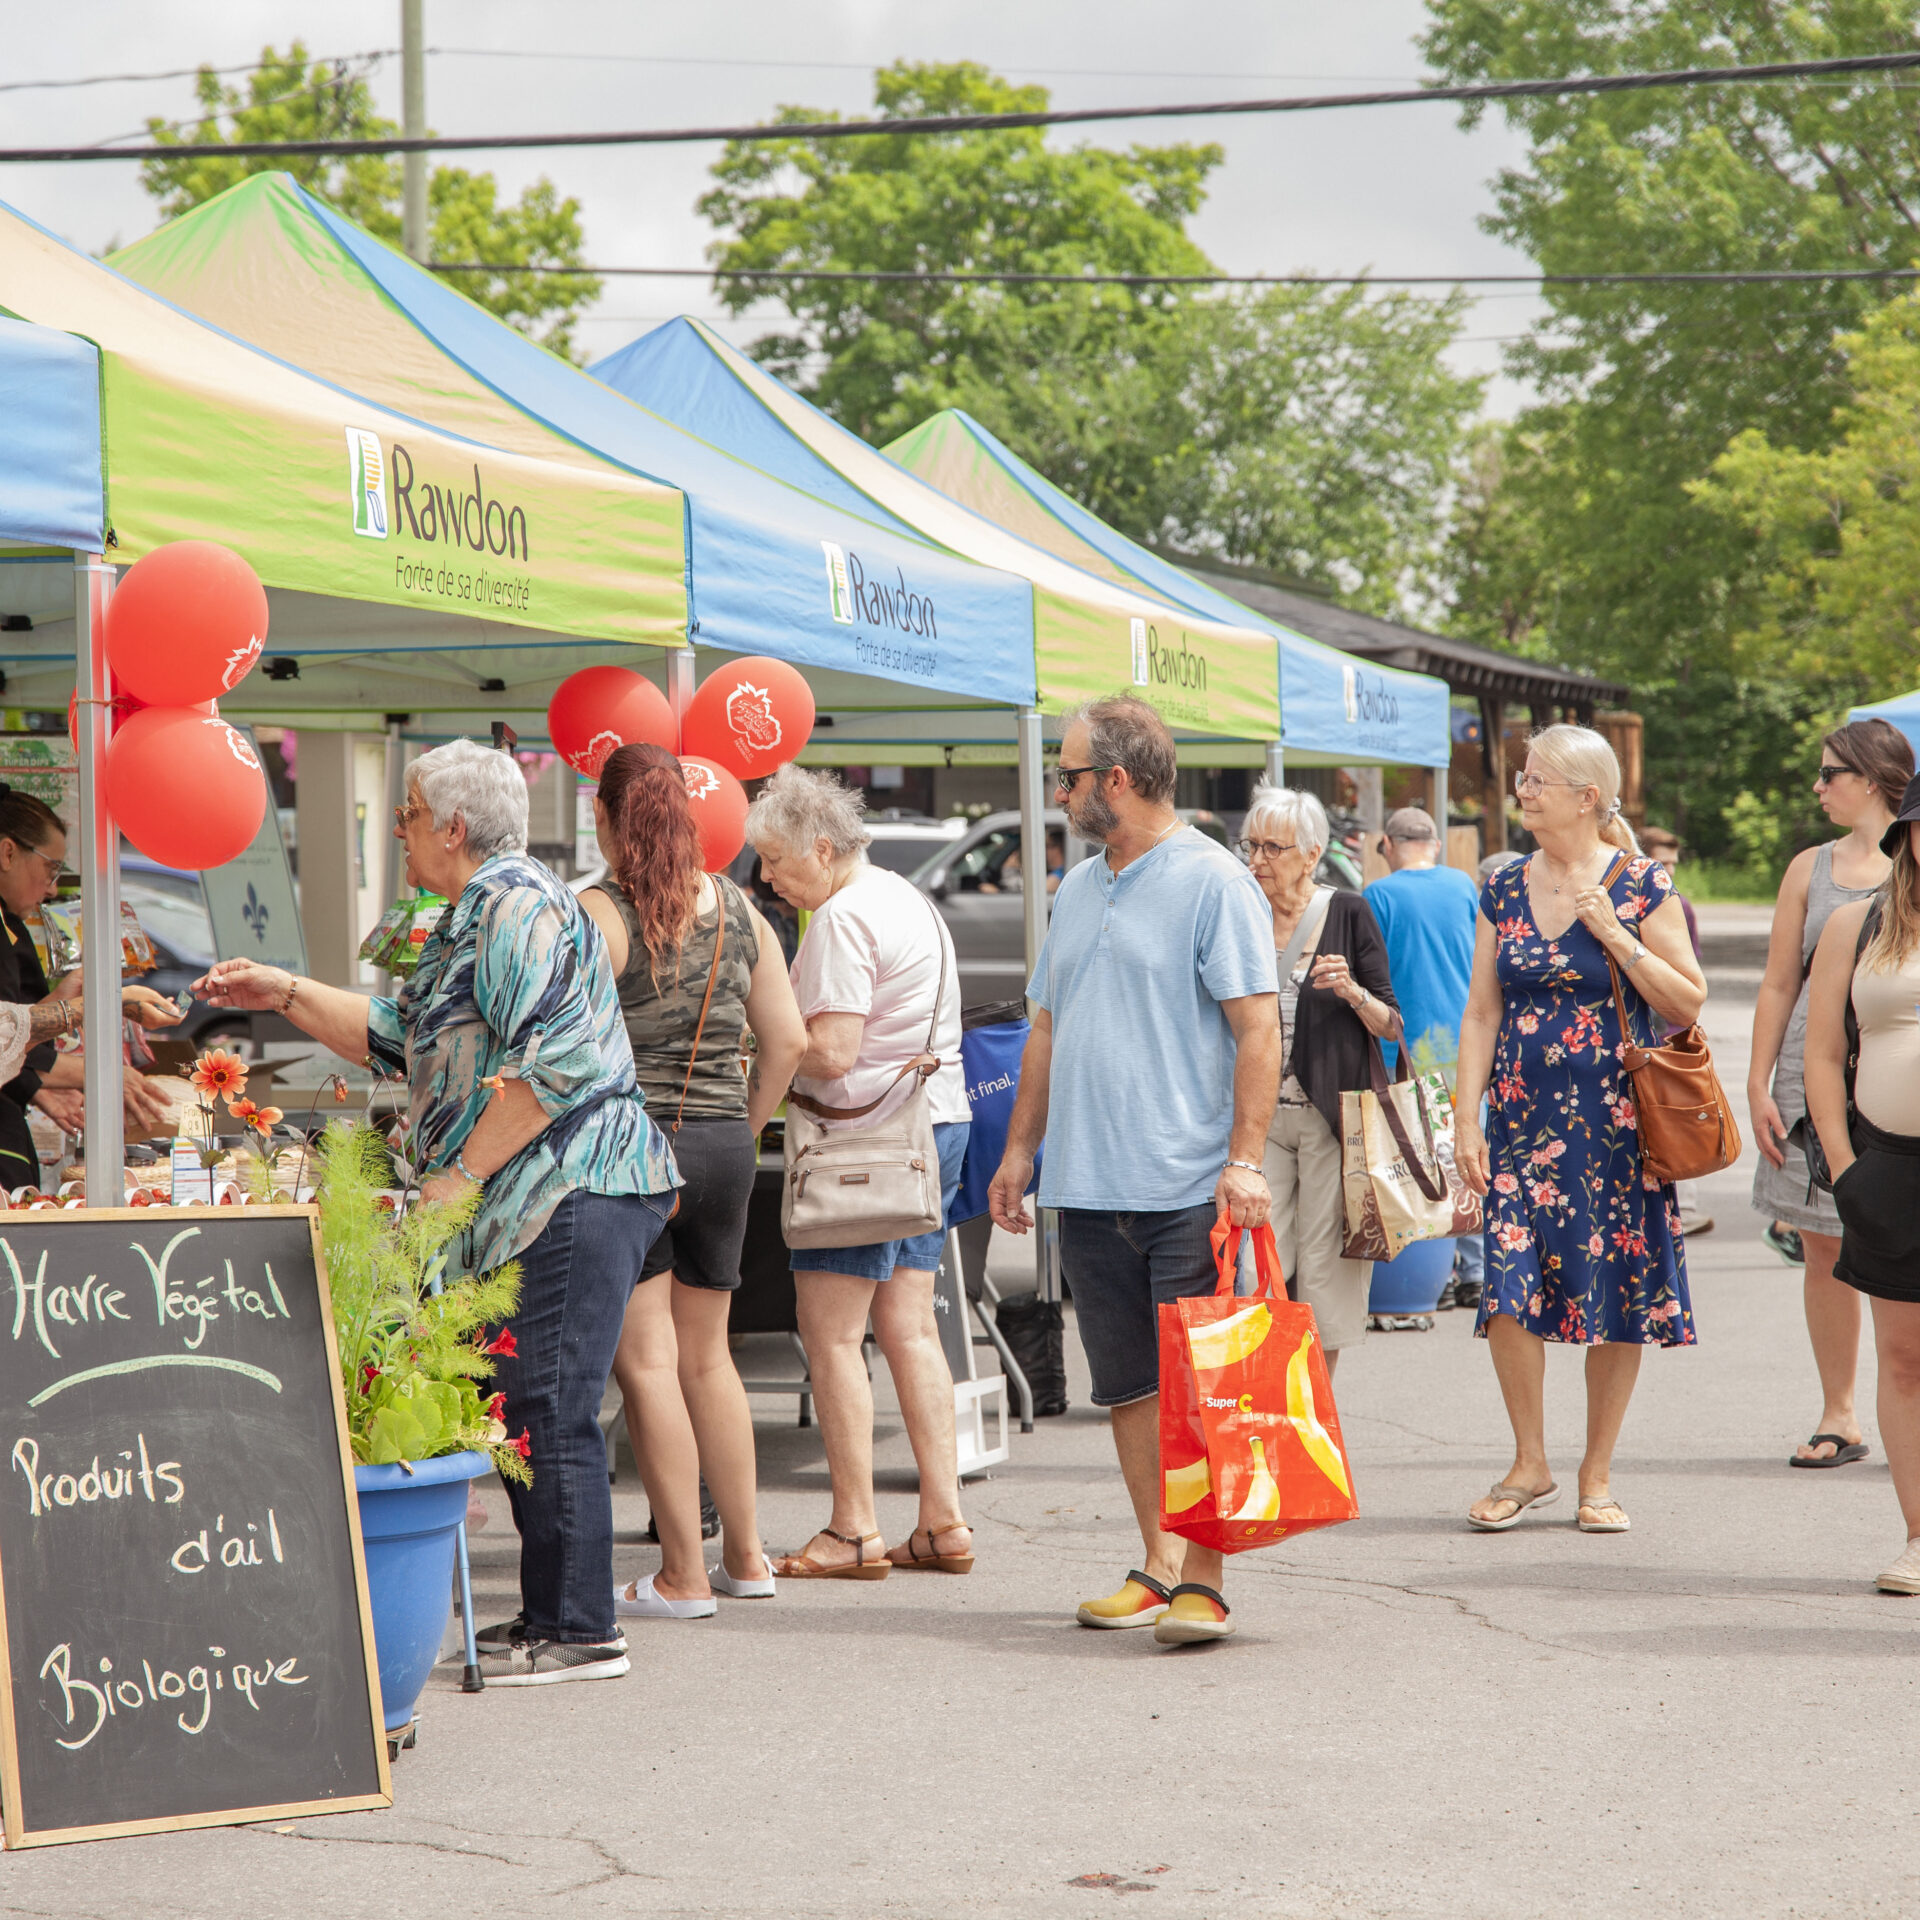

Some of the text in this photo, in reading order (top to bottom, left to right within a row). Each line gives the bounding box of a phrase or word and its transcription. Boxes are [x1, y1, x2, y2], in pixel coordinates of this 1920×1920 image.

[391, 443, 528, 562] Rawdon
[396, 555, 530, 611] Forte de sa diversité
[849, 551, 938, 640] Rawdon
[855, 636, 938, 677] Forte de sa diversité
[1148, 624, 1207, 692] Rawdon
[1356, 671, 1399, 726] Rawdon
[978, 1072, 1015, 1098] final.
[0, 1226, 292, 1358] Havre Végétal
[1206, 1393, 1254, 1413] Super C
[11, 1432, 185, 1517] Produits
[170, 1508, 284, 1573] d'ail
[39, 1643, 310, 1750] Biologique
